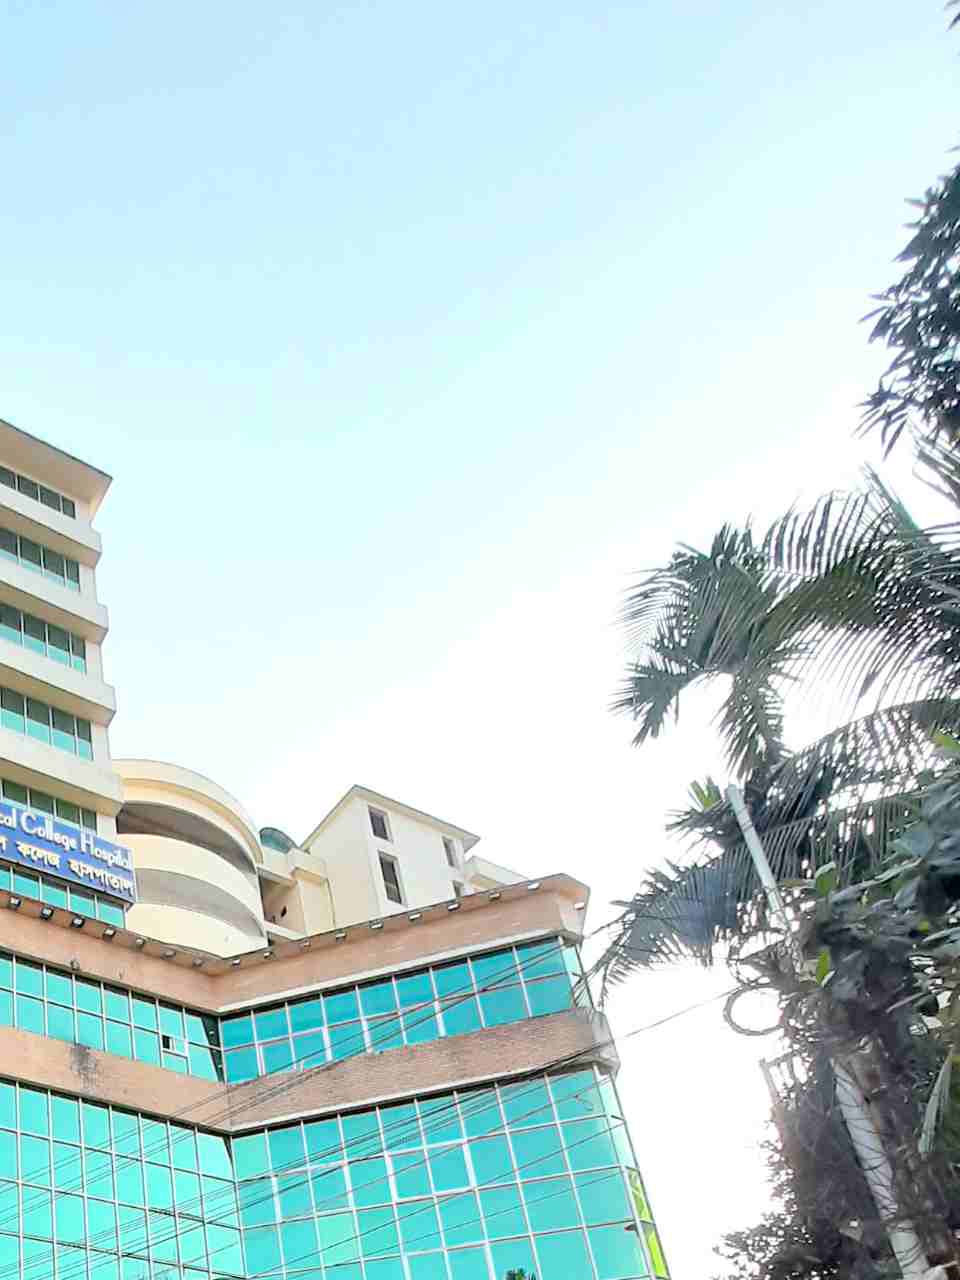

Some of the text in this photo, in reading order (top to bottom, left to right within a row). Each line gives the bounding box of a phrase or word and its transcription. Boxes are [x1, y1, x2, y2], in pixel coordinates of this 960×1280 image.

[20, 813, 77, 851] College
[80, 831, 134, 868] Hospital
[18, 843, 61, 868] কলেজ
[68, 858, 134, 893] হাসপাতাল
